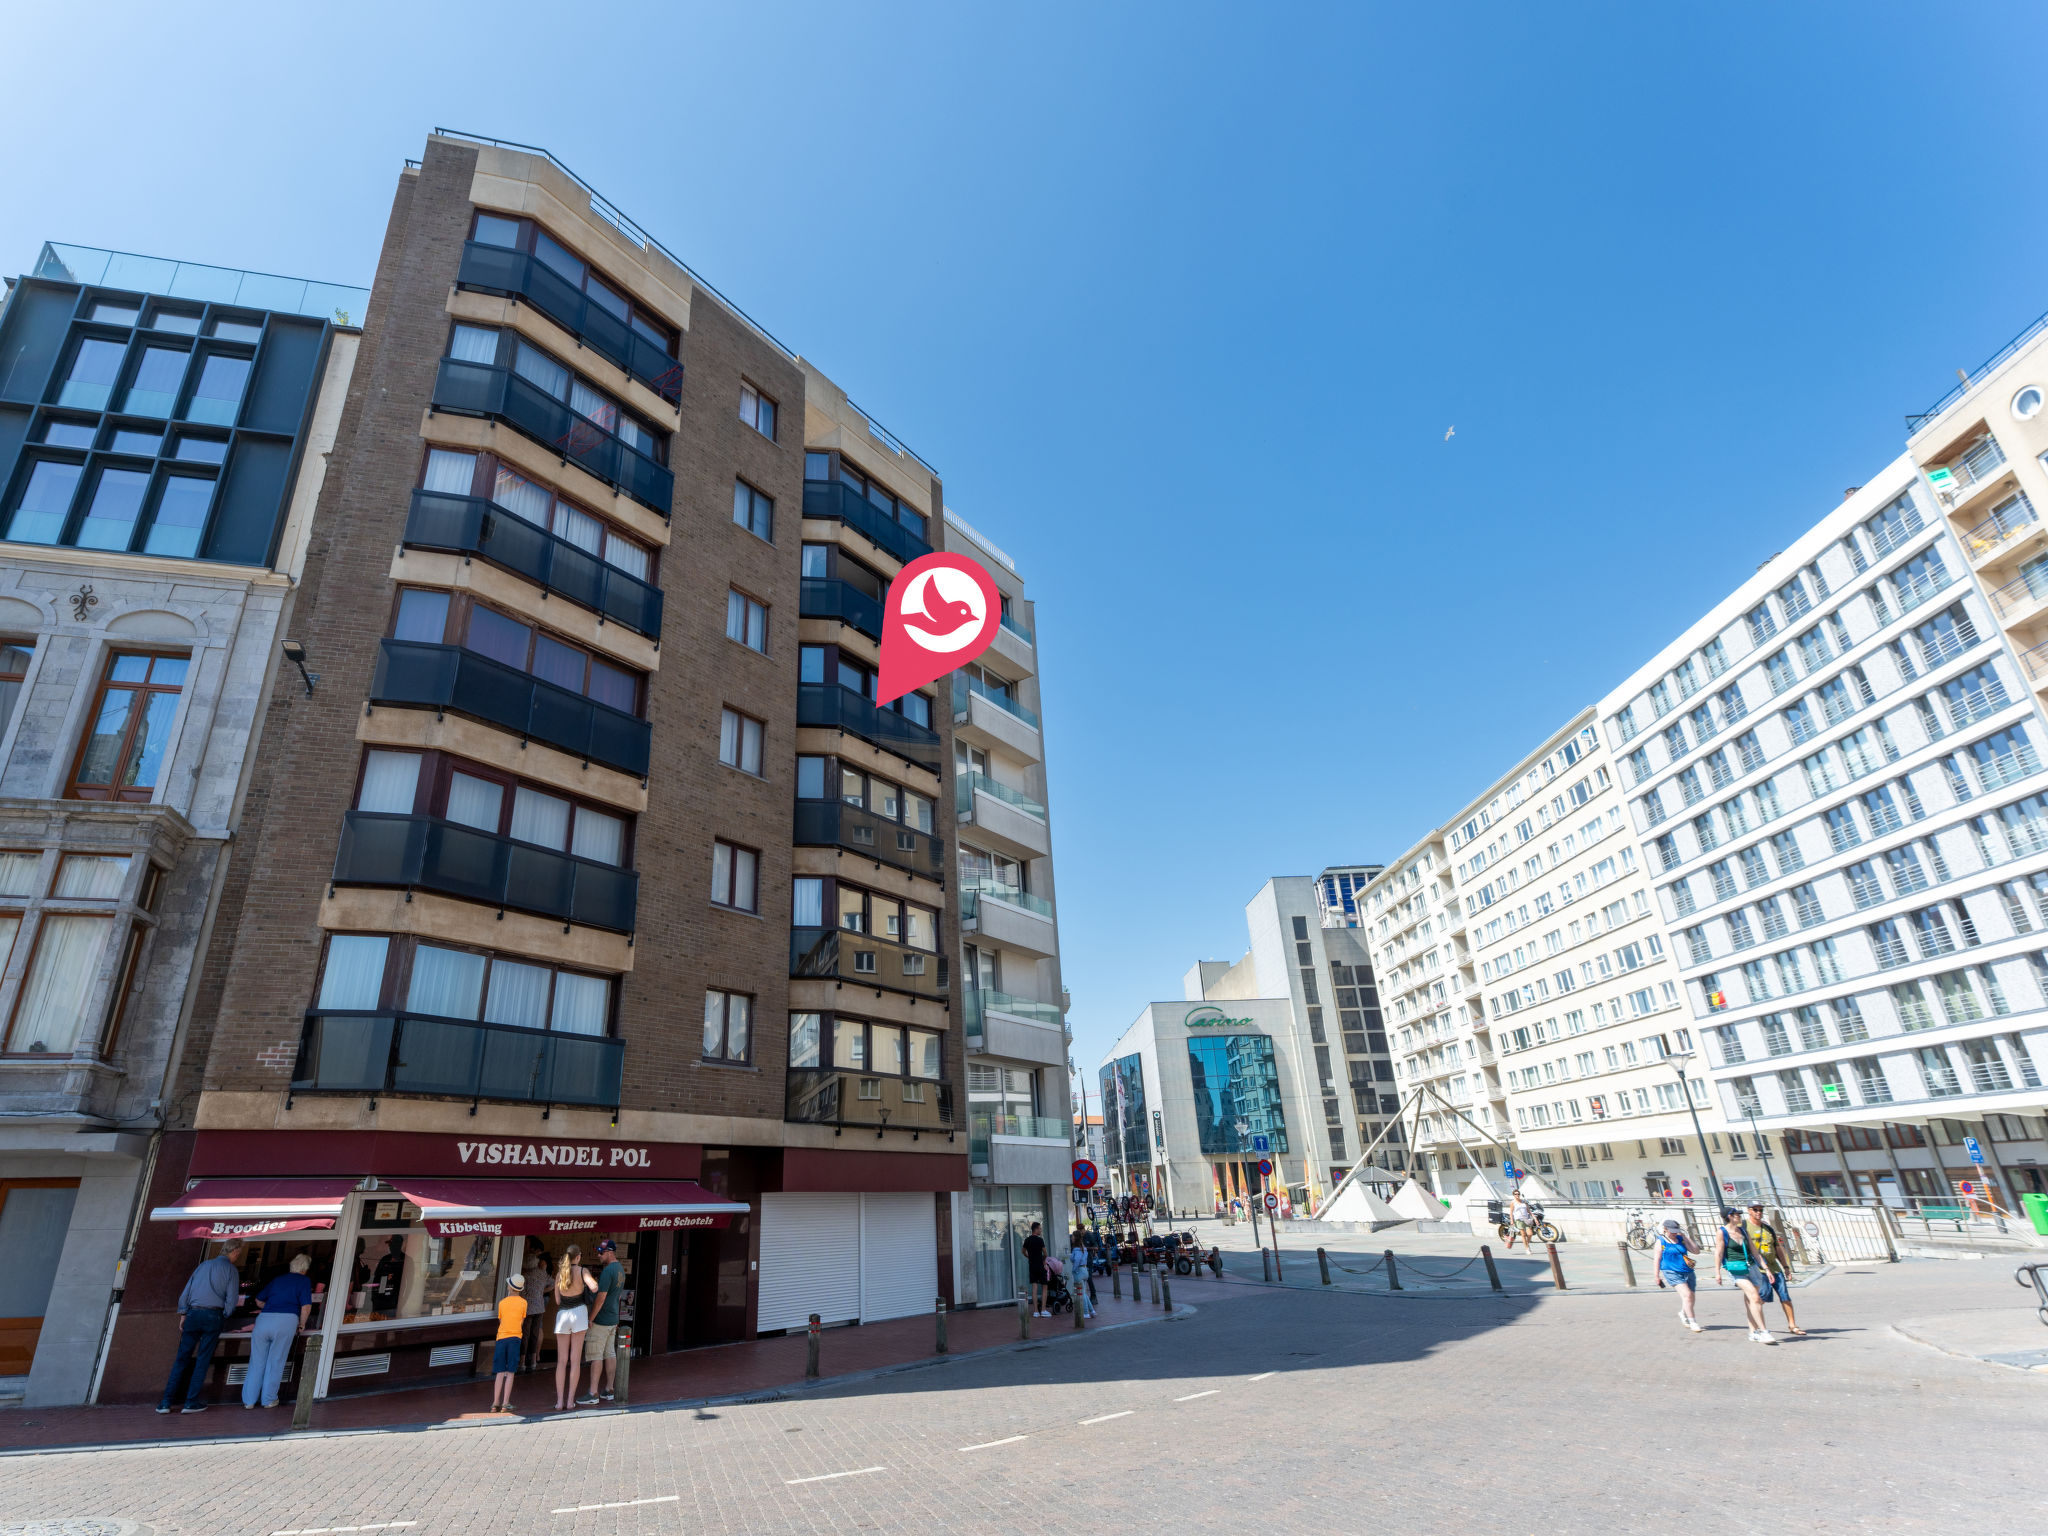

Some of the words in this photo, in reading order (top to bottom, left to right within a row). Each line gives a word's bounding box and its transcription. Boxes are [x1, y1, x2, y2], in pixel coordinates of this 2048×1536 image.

[1185, 1006, 1254, 1027] Casino
[1967, 1138, 1976, 1148] P
[457, 1142, 604, 1166] VISHANDEL
[610, 1148, 651, 1167] POL
[211, 1220, 287, 1234] Broodjes
[439, 1222, 503, 1235] Kibbeling
[549, 1219, 597, 1231] Traiteur
[639, 1217, 672, 1228] Koude
[673, 1216, 714, 1226] Schotels
